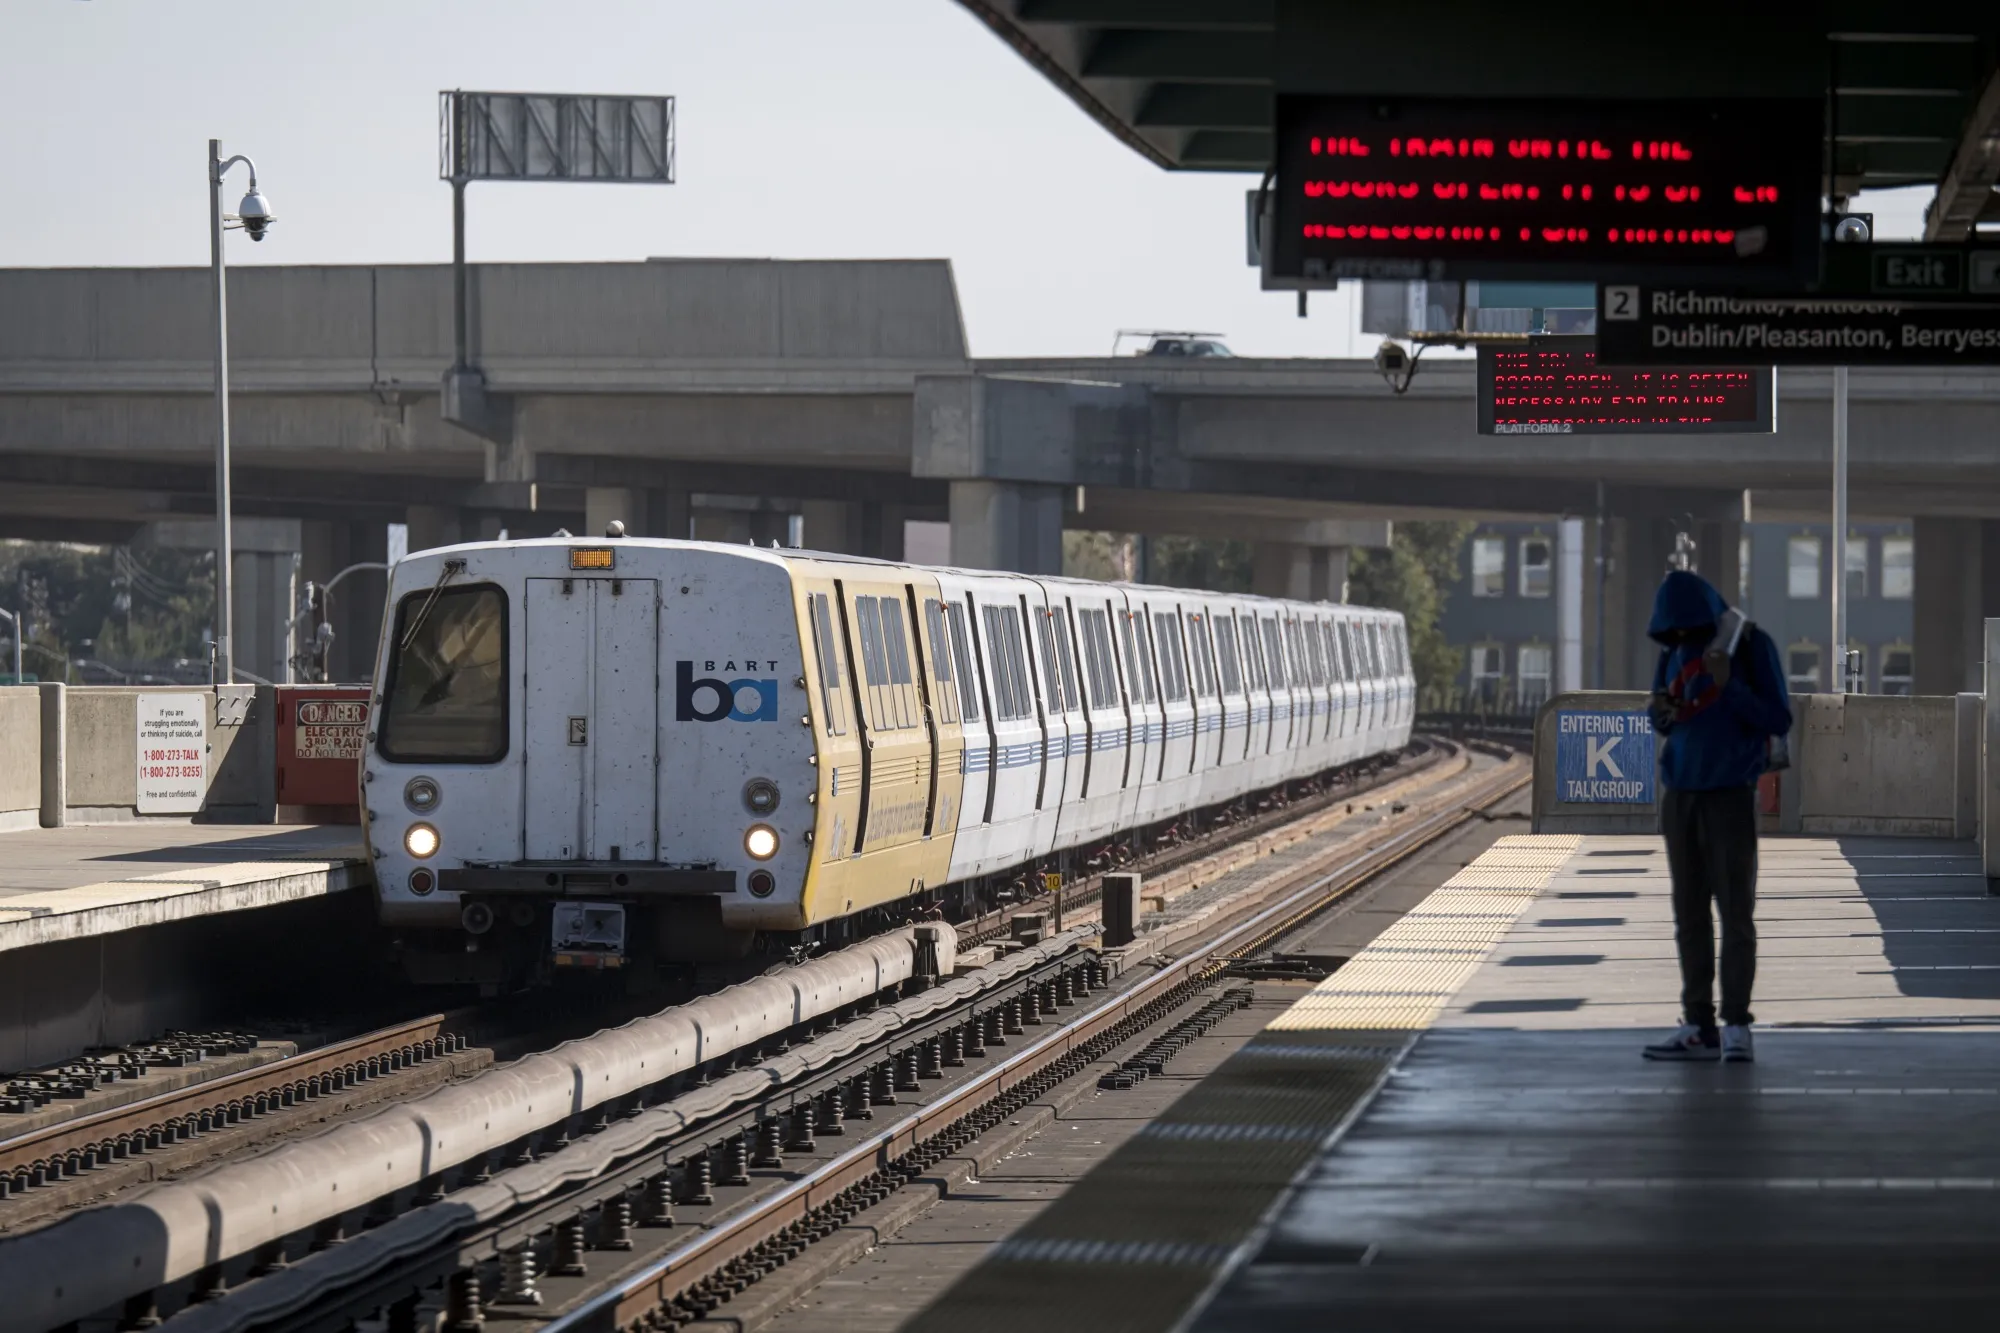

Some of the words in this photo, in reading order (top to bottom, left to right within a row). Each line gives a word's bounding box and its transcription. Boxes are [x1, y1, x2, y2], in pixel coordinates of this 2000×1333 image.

[1886, 257, 1945, 286] Exit
[1613, 291, 1630, 315] 2
[1652, 323, 1892, 350] Dublin/Pleasanton,
[1901, 324, 2000, 353] Berryes
[1496, 424, 1558, 433] PLATFORM
[1563, 424, 1572, 433] 2
[705, 660, 778, 671] BART
[309, 705, 361, 722] DANGER
[144, 720, 170, 728] struggling
[171, 719, 199, 728] emotionally
[1560, 715, 1624, 733] ENTERING
[1627, 716, 1652, 734] THE
[148, 730, 168, 739] thinking
[176, 730, 194, 738] suicide,
[305, 727, 364, 737] ELECTRIC
[144, 749, 199, 760] 1-800-273-TALK
[297, 749, 312, 757] DO
[315, 749, 334, 757] NOT
[1587, 736, 1624, 778] K
[140, 765, 203, 779] (1-800-273-8255)
[1567, 780, 1644, 798] TALKGROUP
[1048, 876, 1060, 886] 10
